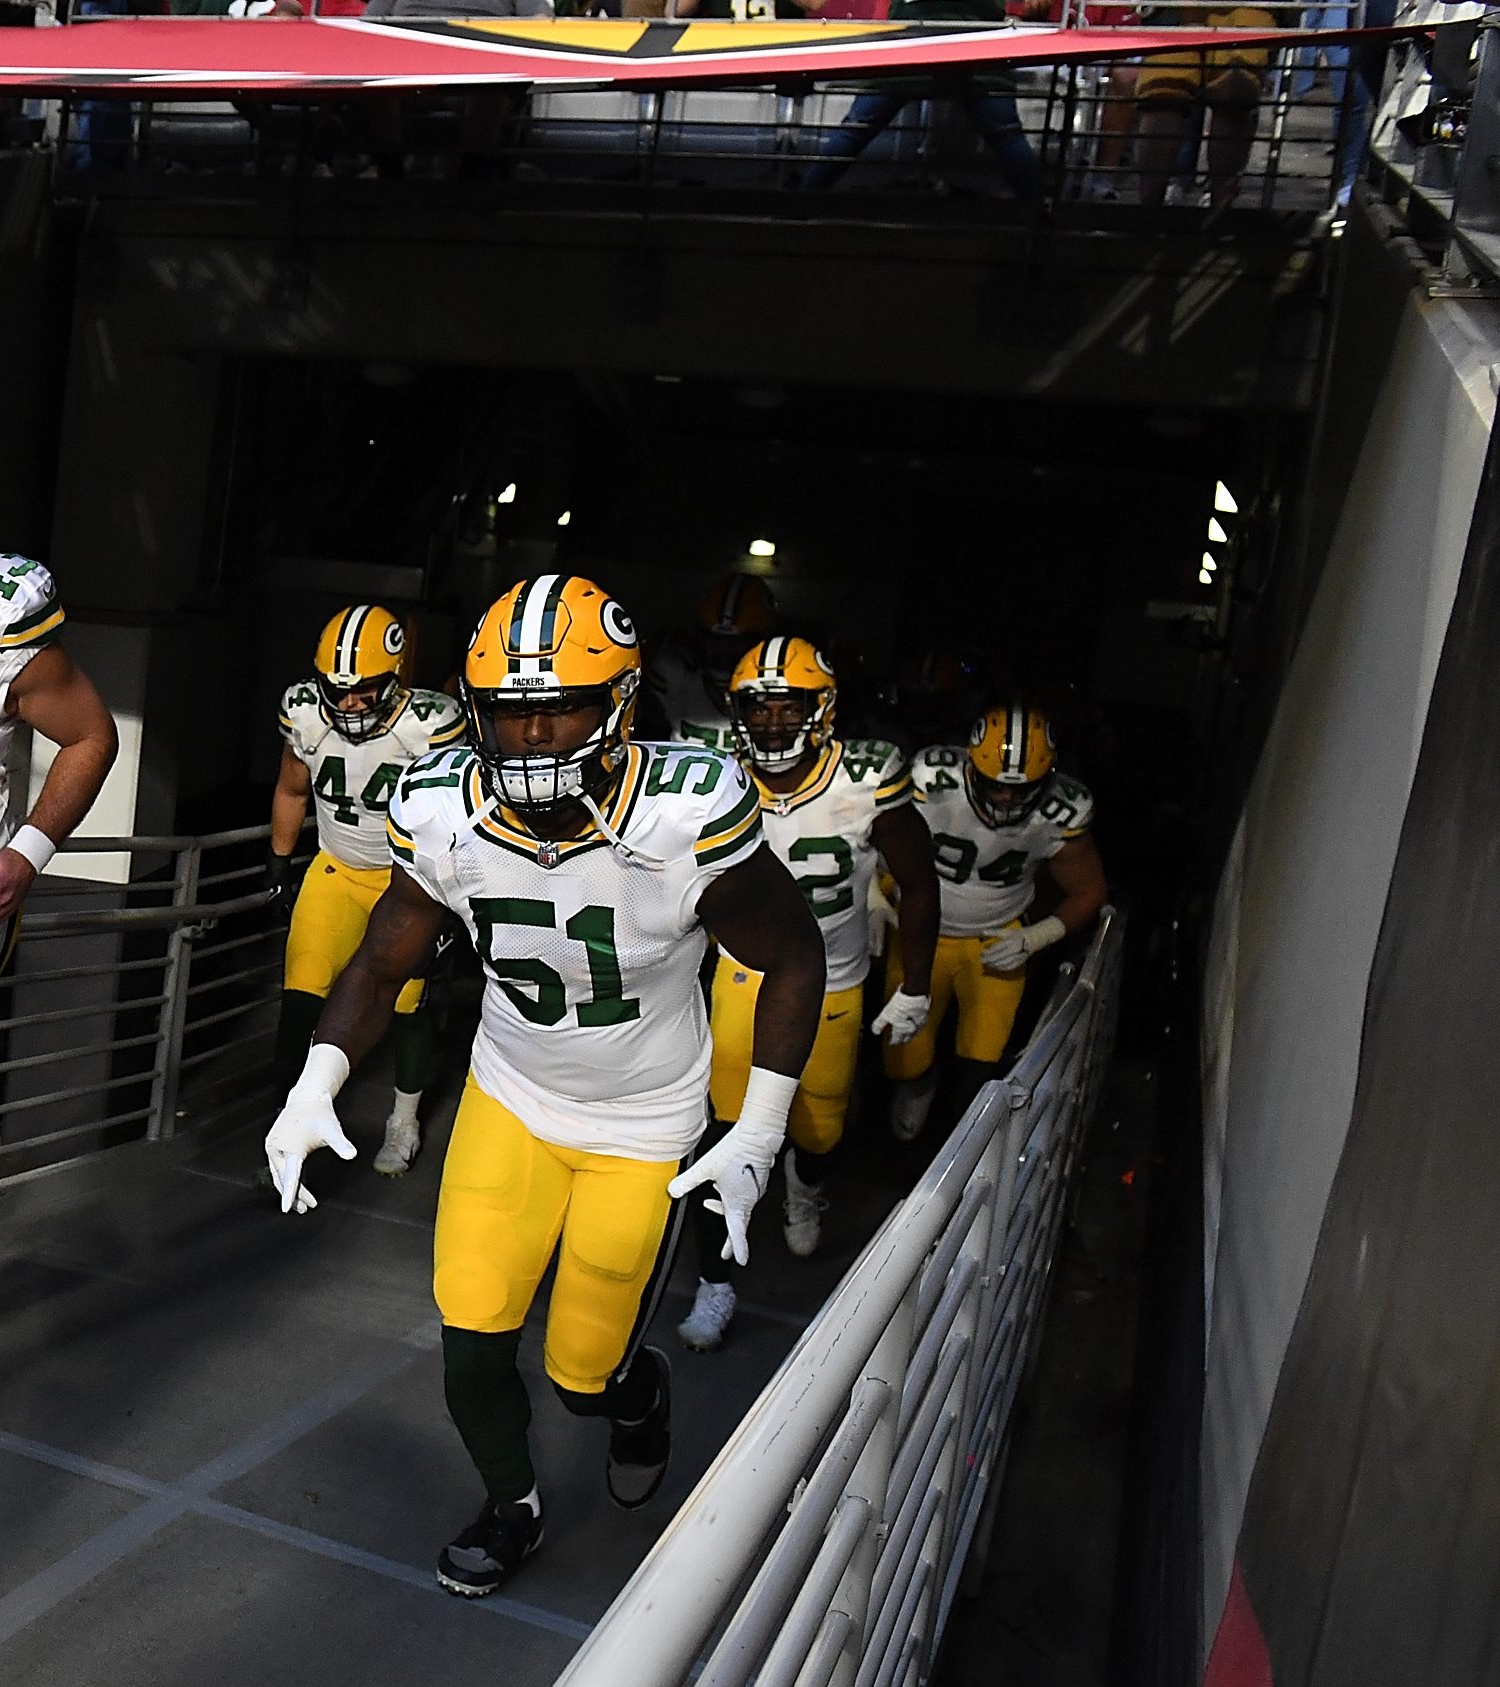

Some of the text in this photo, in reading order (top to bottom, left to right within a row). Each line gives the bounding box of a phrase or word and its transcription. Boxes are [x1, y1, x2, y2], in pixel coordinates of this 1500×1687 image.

[603, 601, 638, 646] G
[512, 677, 546, 687] PACKERS
[764, 836, 854, 918] 2
[932, 832, 1030, 888] 94
[468, 896, 642, 1028] 51
